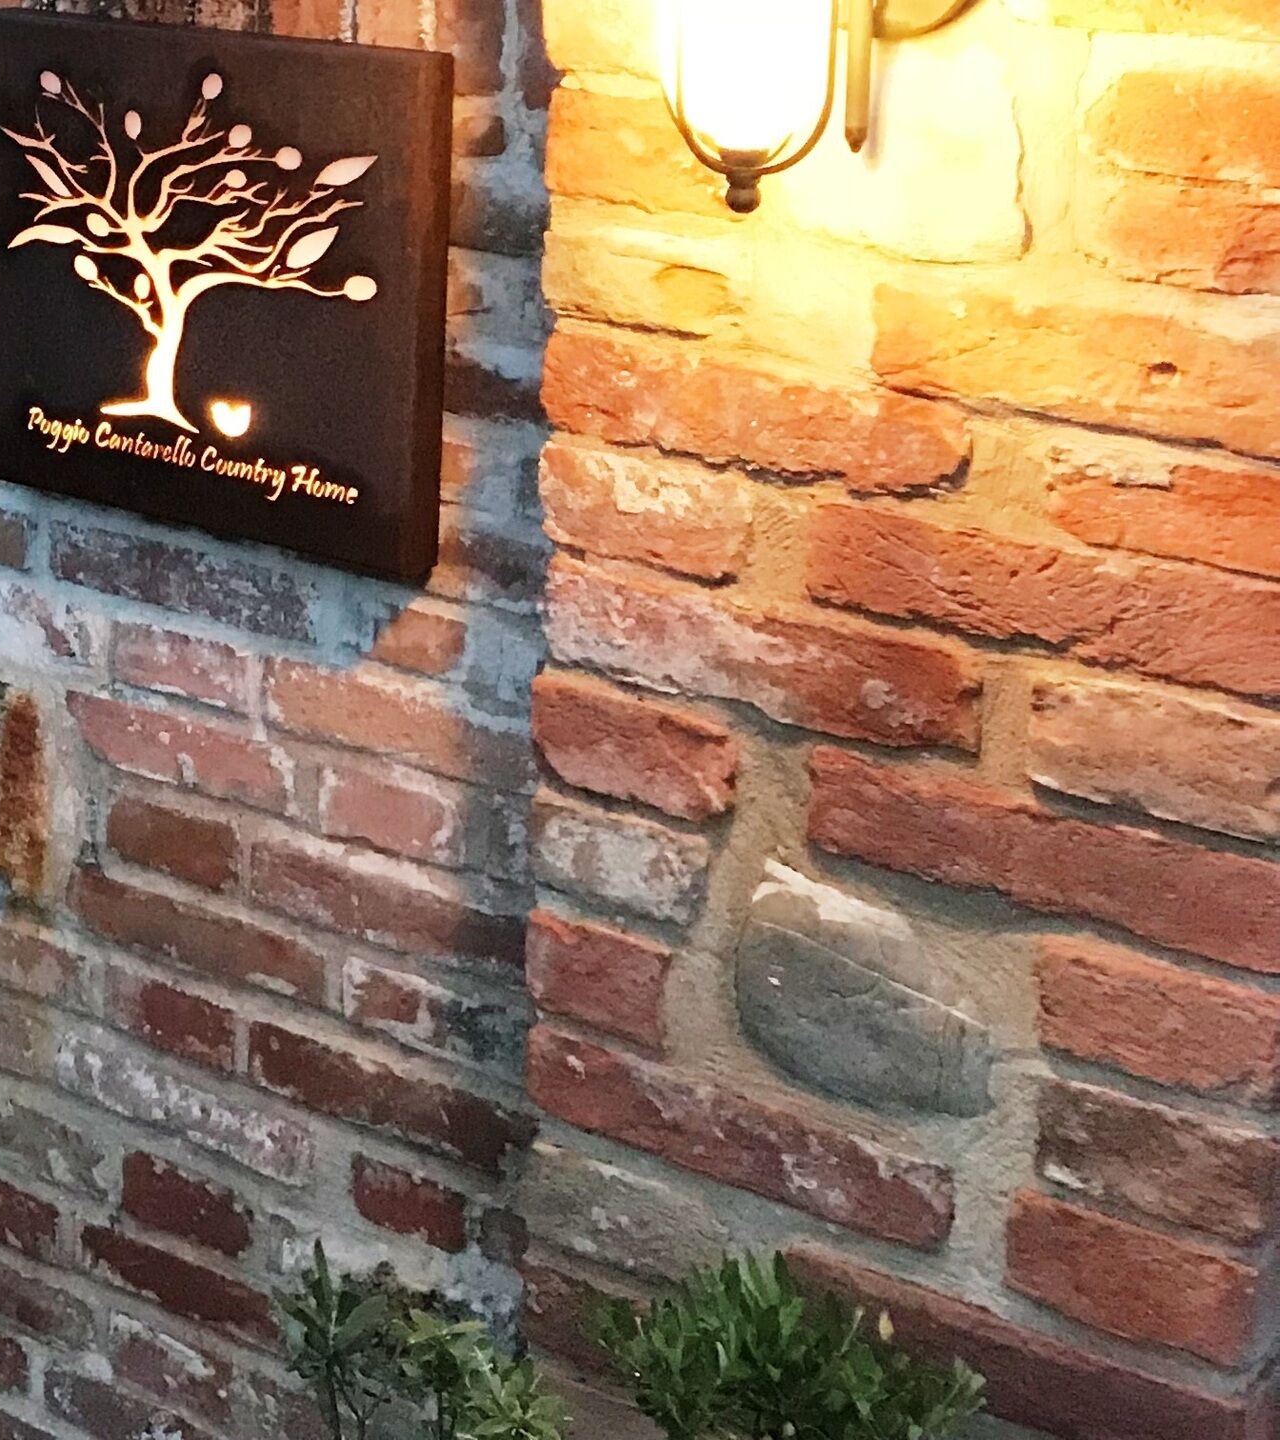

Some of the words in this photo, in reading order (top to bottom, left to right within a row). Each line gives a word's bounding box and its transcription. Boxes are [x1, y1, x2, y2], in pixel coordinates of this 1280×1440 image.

[27, 407, 90, 453] Poggio
[95, 421, 196, 467] Cantarello
[200, 446, 286, 501] Country
[290, 465, 359, 505] Home
